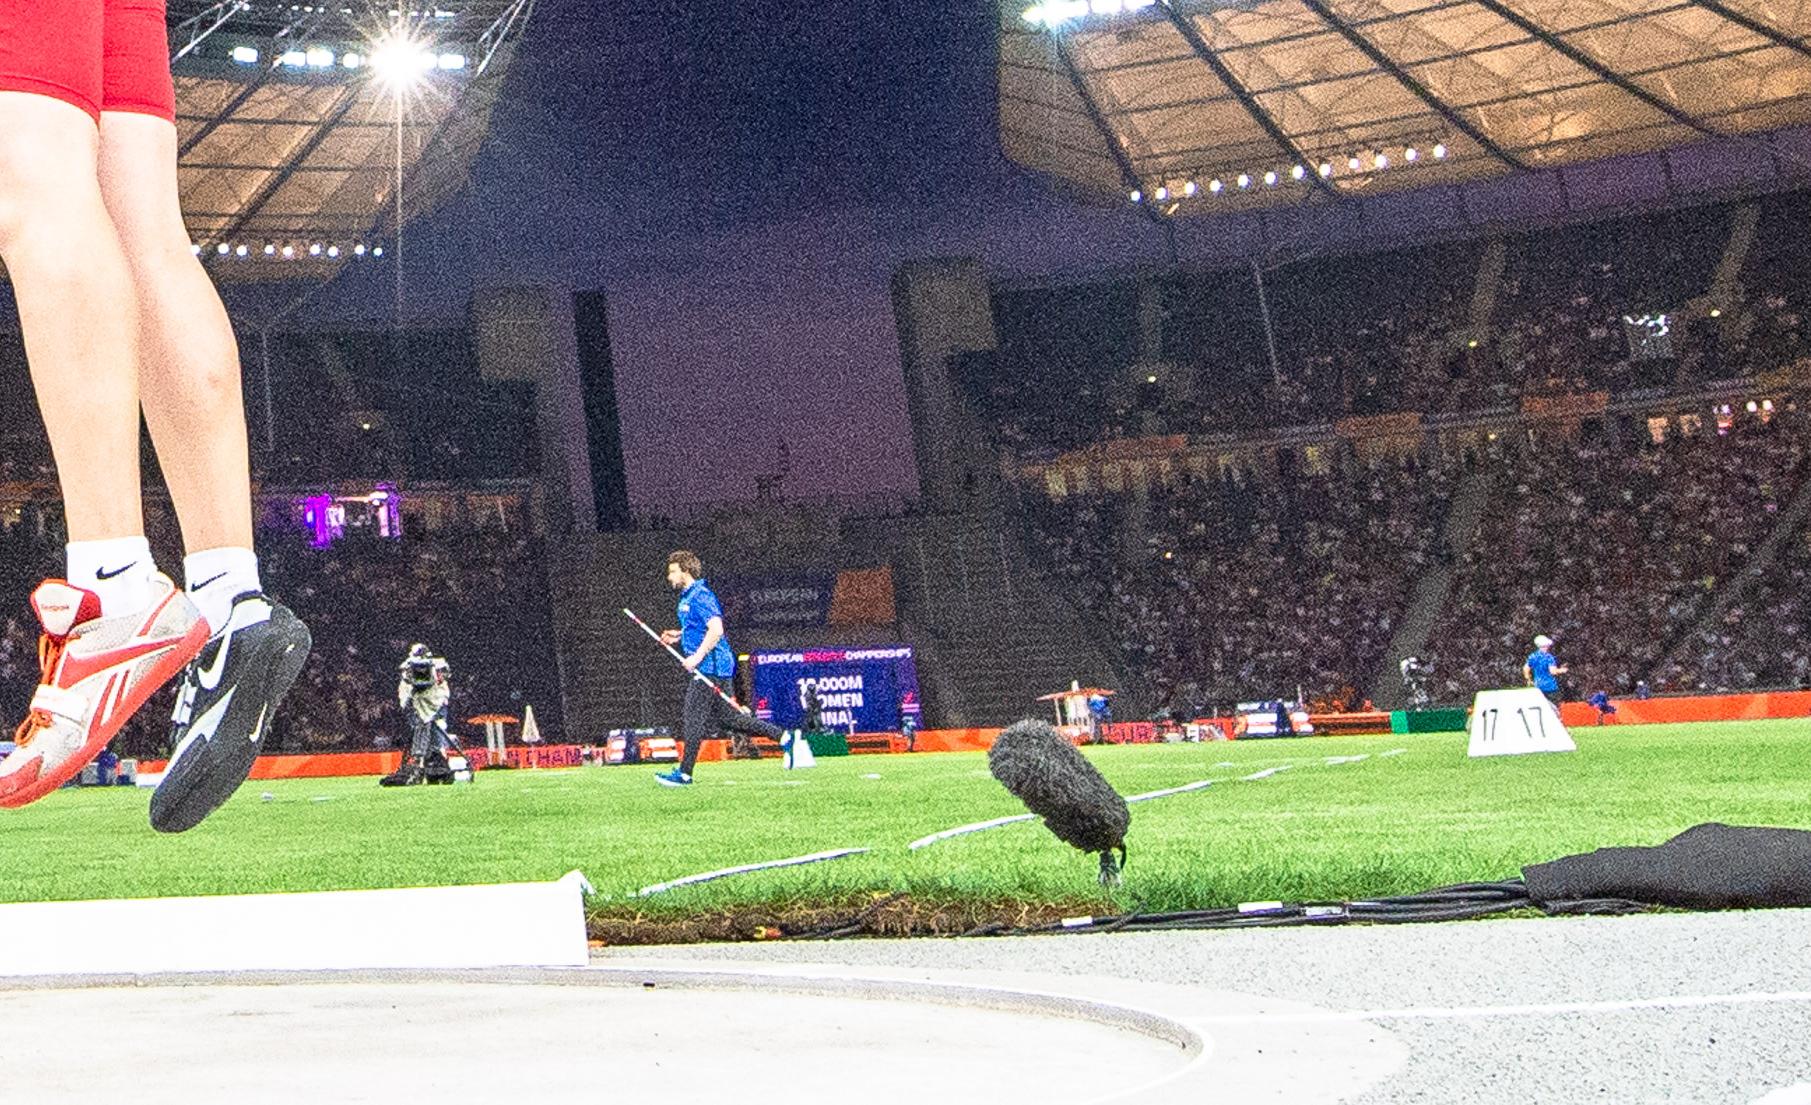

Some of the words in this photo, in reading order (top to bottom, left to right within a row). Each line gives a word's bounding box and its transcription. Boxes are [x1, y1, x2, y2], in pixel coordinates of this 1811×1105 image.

[757, 653, 804, 665] EUROPEAN
[800, 692, 863, 709] OMEN
[1482, 709, 1498, 741] 17
[1516, 706, 1545, 738] 17
